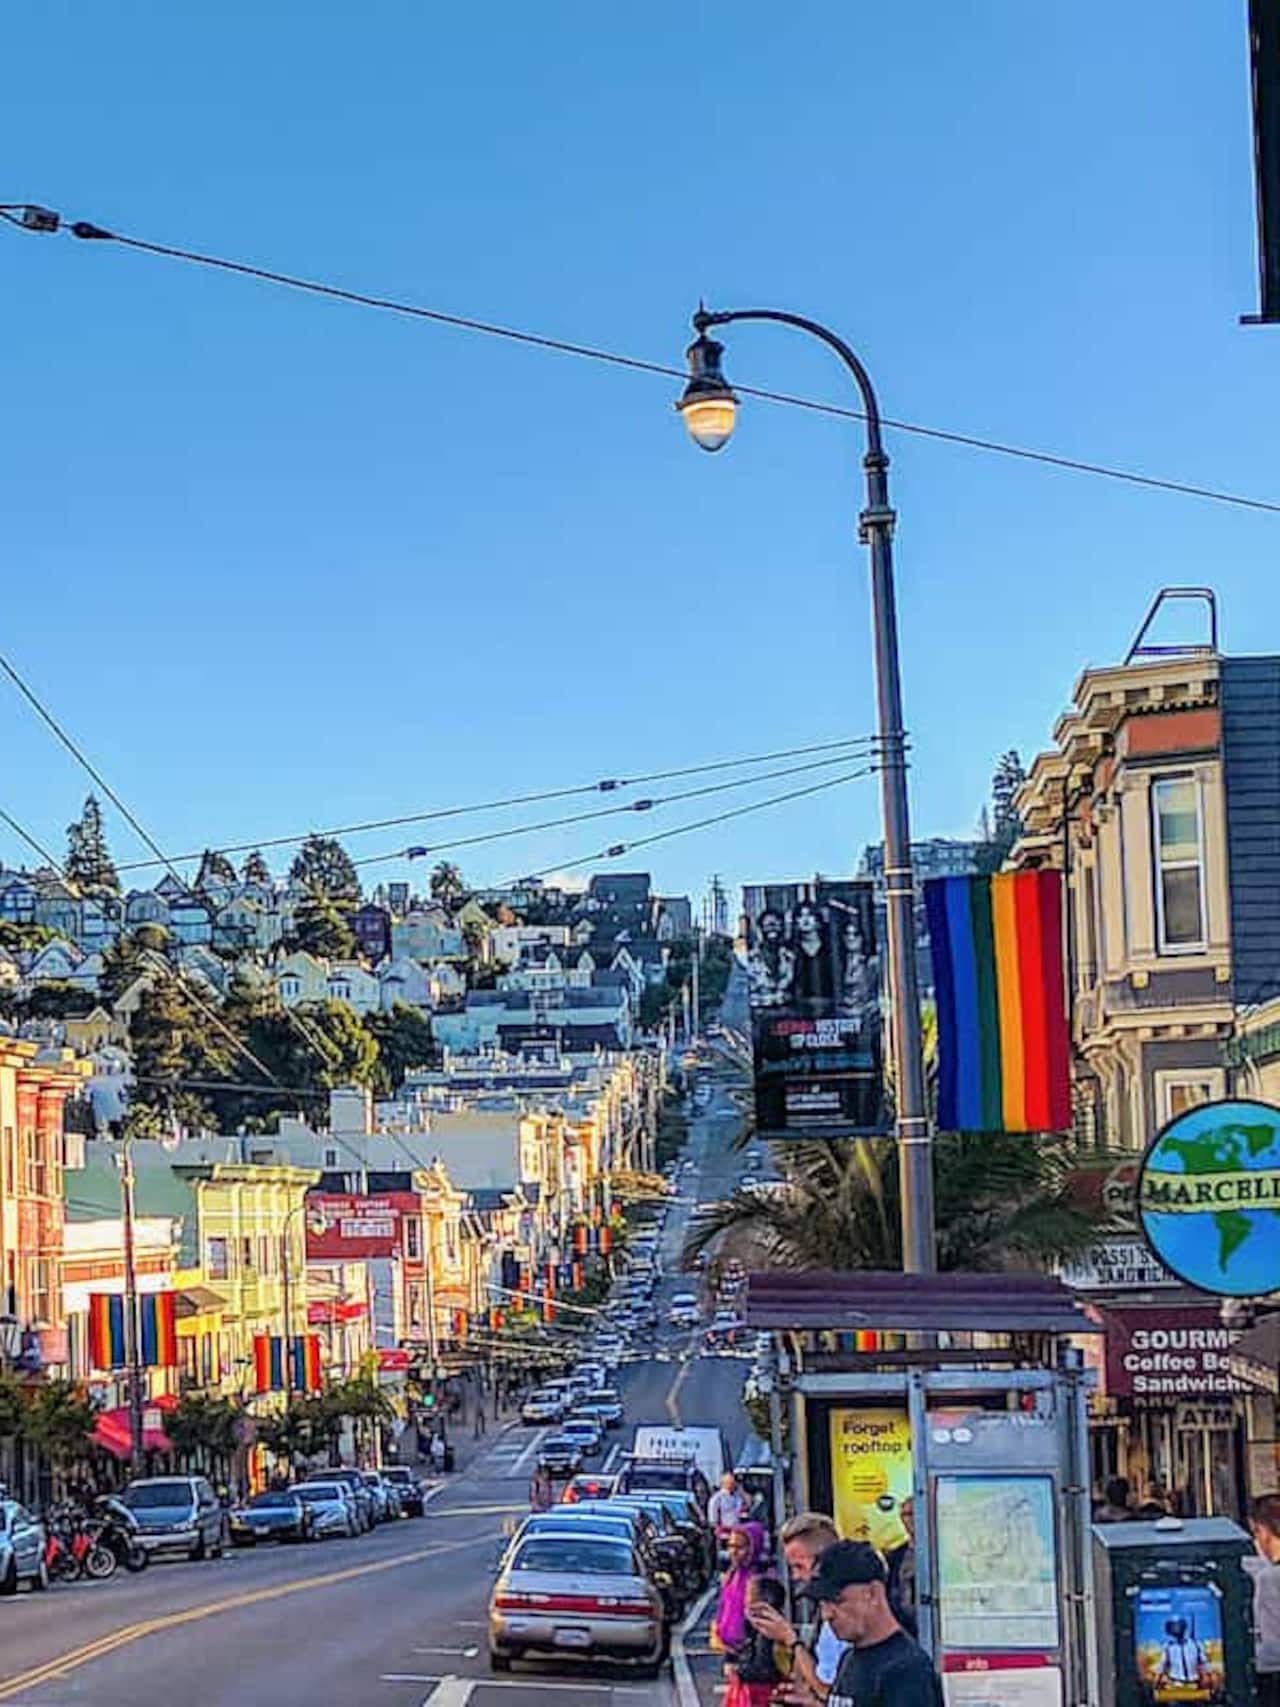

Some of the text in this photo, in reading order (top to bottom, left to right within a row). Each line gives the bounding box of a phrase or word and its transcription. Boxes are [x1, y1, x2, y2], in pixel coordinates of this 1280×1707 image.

[1131, 1330, 1243, 1349] GOURME
[1123, 1353, 1197, 1371] Coffee
[1183, 1408, 1234, 1425] ATM
[843, 1421, 895, 1436] Forget
[843, 1441, 902, 1453] rooftop
